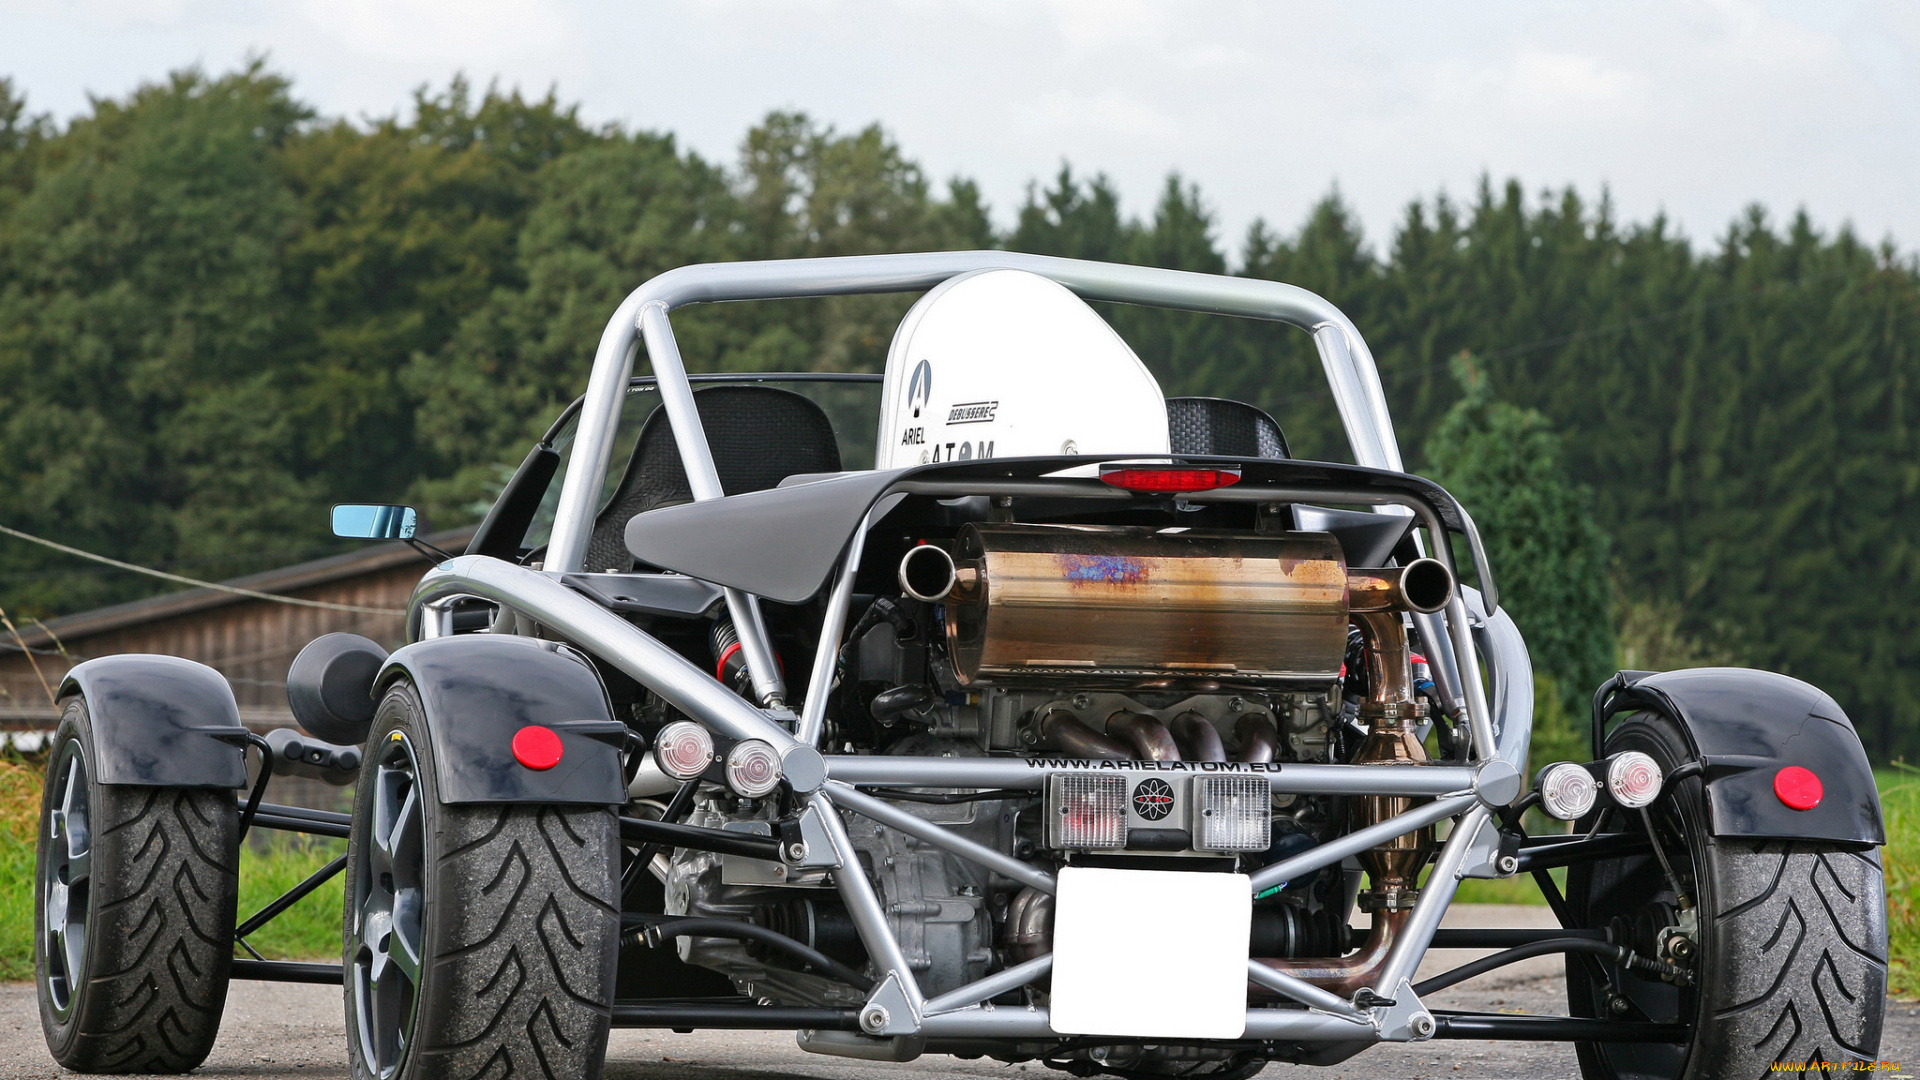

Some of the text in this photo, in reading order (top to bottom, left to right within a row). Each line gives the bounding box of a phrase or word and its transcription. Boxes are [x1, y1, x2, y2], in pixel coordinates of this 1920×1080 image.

[902, 427, 925, 446] ARIEL
[932, 441, 995, 463] ATOM
[1026, 758, 1282, 772] WWW.ARIELATOM.EU
